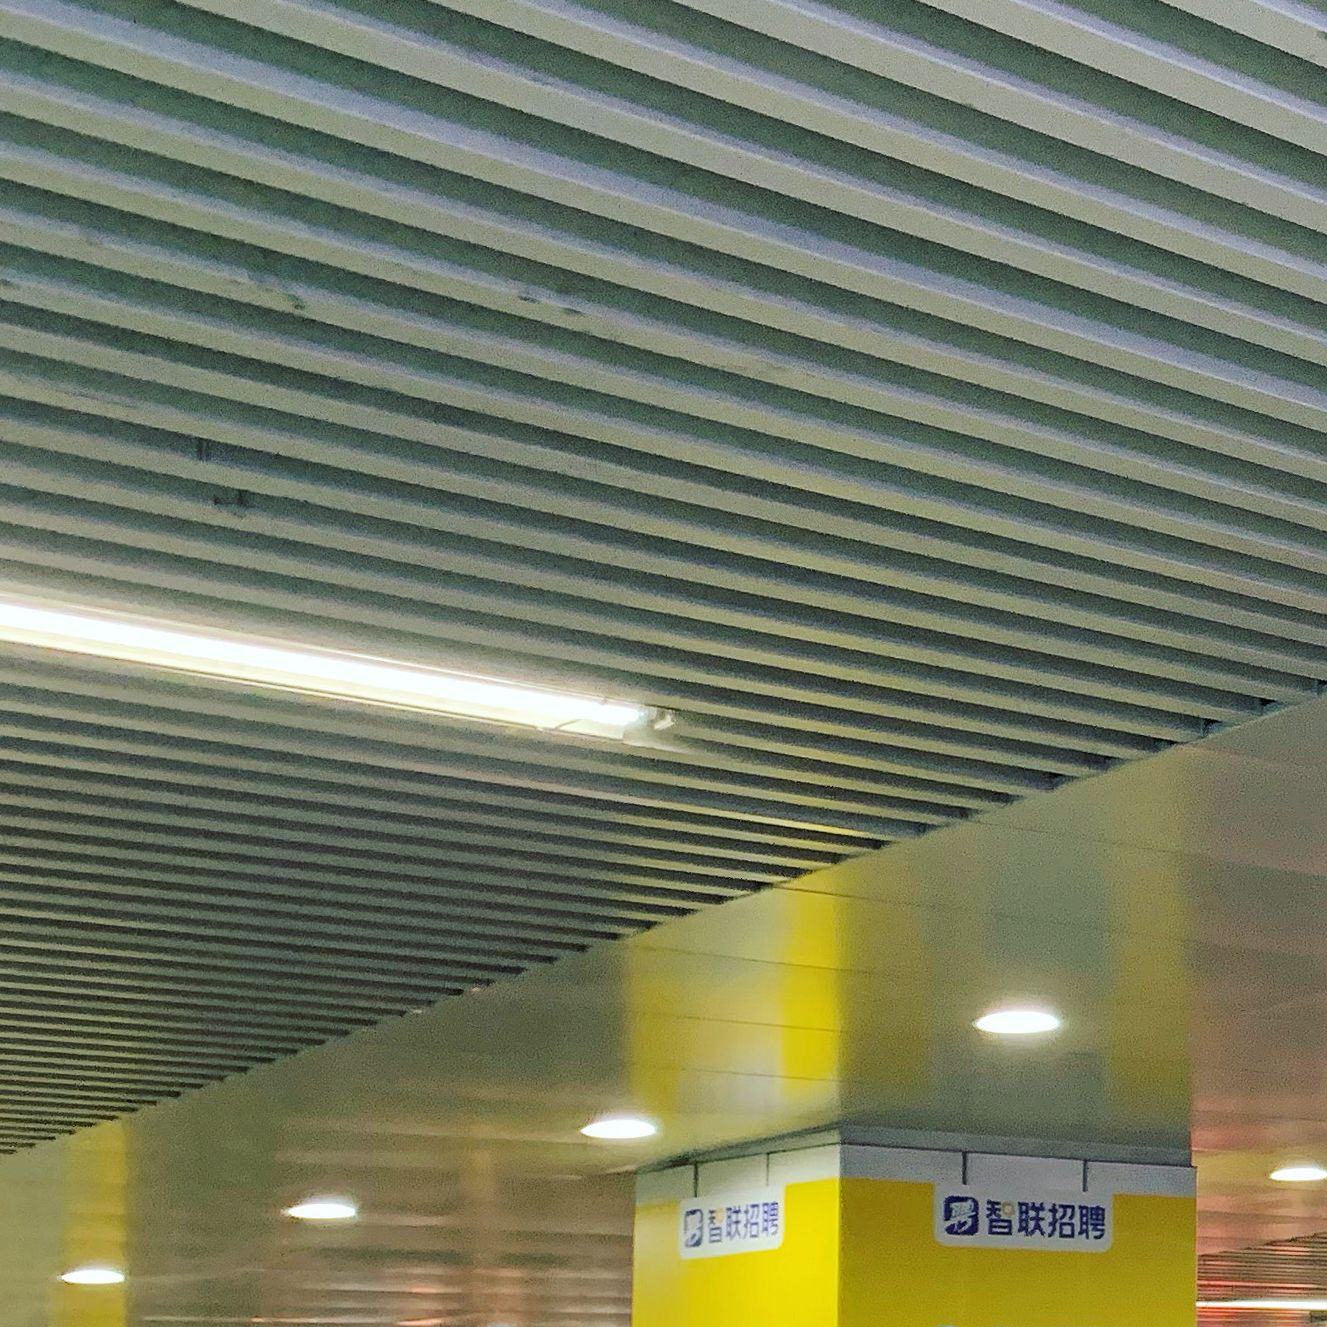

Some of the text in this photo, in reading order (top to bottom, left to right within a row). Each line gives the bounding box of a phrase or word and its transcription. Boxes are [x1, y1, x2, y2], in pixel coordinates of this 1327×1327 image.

[708, 1201, 779, 1244] 智联招聘
[986, 1199, 1105, 1240] 智联招聘
